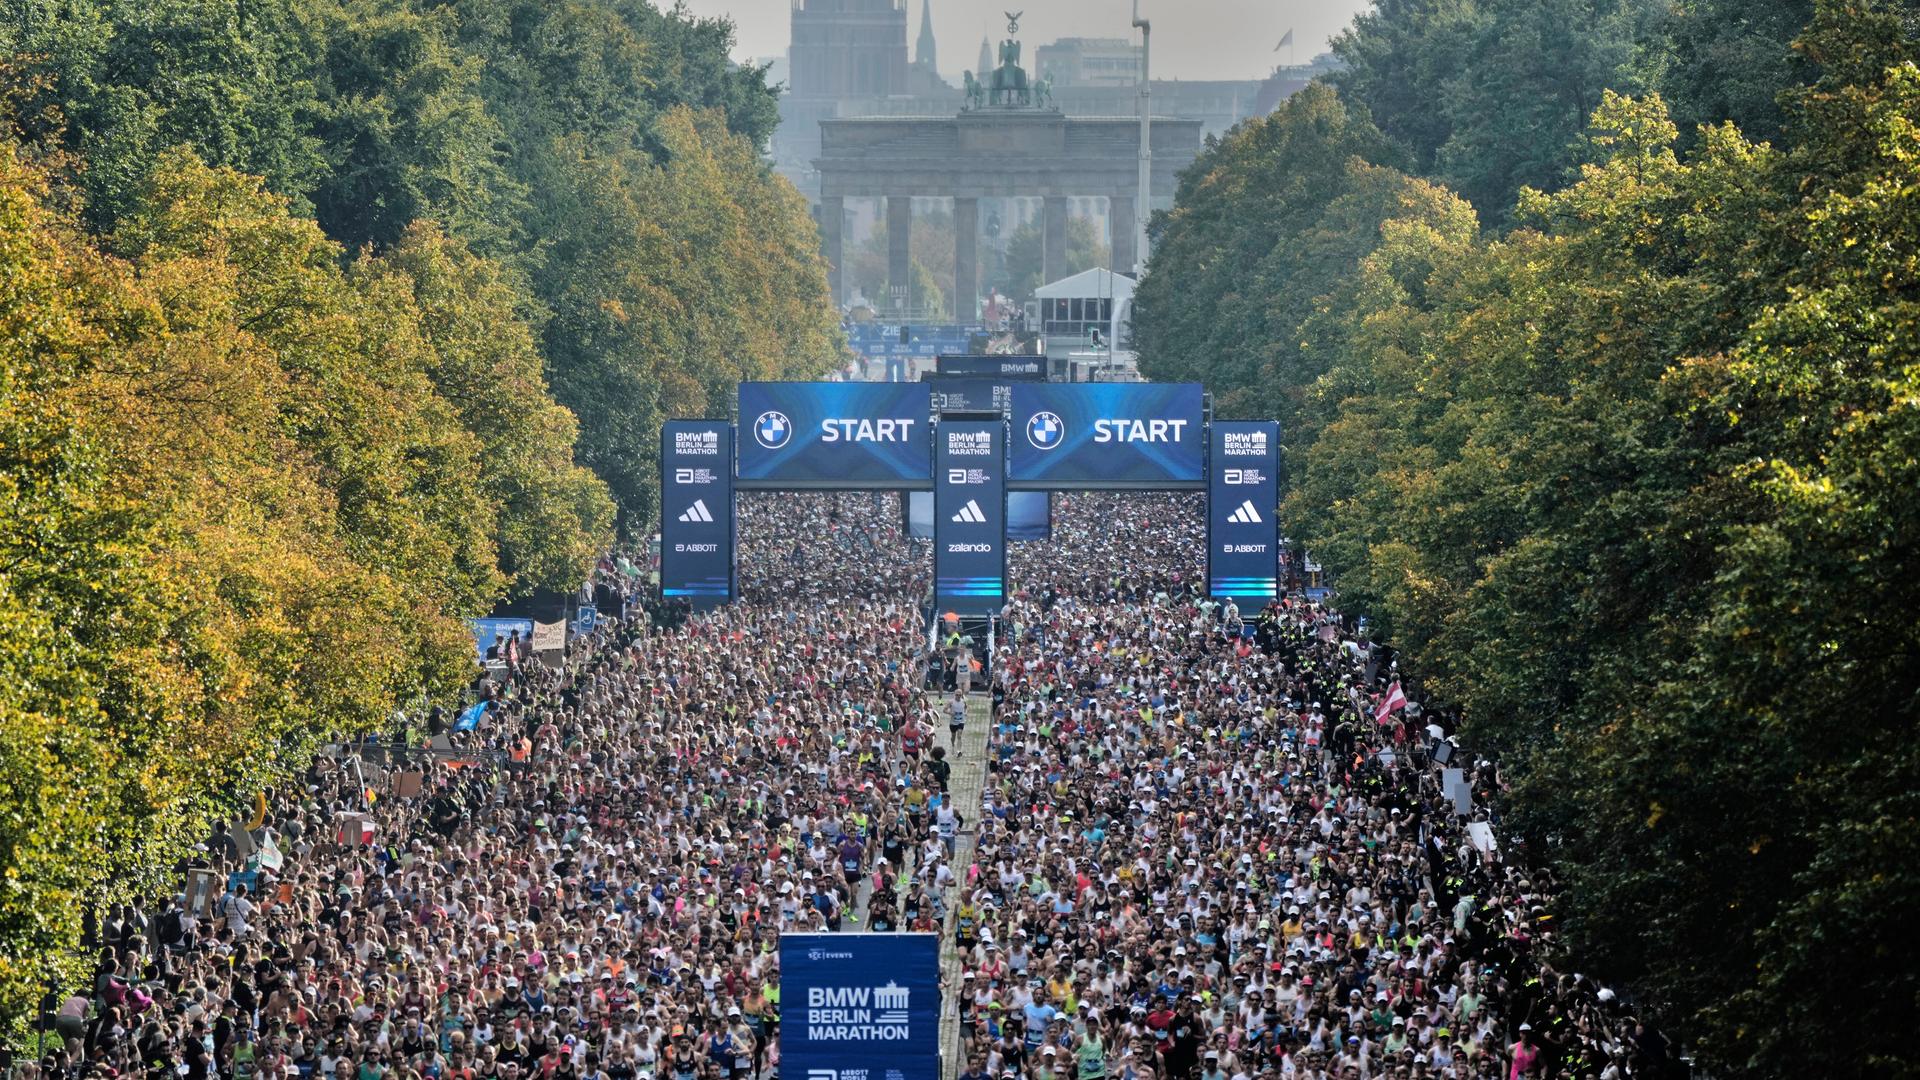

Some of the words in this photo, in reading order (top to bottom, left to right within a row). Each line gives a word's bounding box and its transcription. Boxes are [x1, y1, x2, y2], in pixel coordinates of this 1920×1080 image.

[1001, 364, 1024, 372] BMW
[759, 414, 786, 424] BMW
[1032, 414, 1059, 424] BMW
[822, 419, 914, 442] START
[1094, 419, 1187, 442] START
[676, 433, 701, 442] BMW
[949, 433, 974, 442] BMW
[1225, 433, 1250, 442] BMW
[948, 543, 991, 552] zalando
[1234, 544, 1266, 553] ABBOTT
[808, 987, 870, 1007] BMW
[808, 1010, 870, 1024] BERLIN
[808, 1026, 909, 1040] MARATHON
